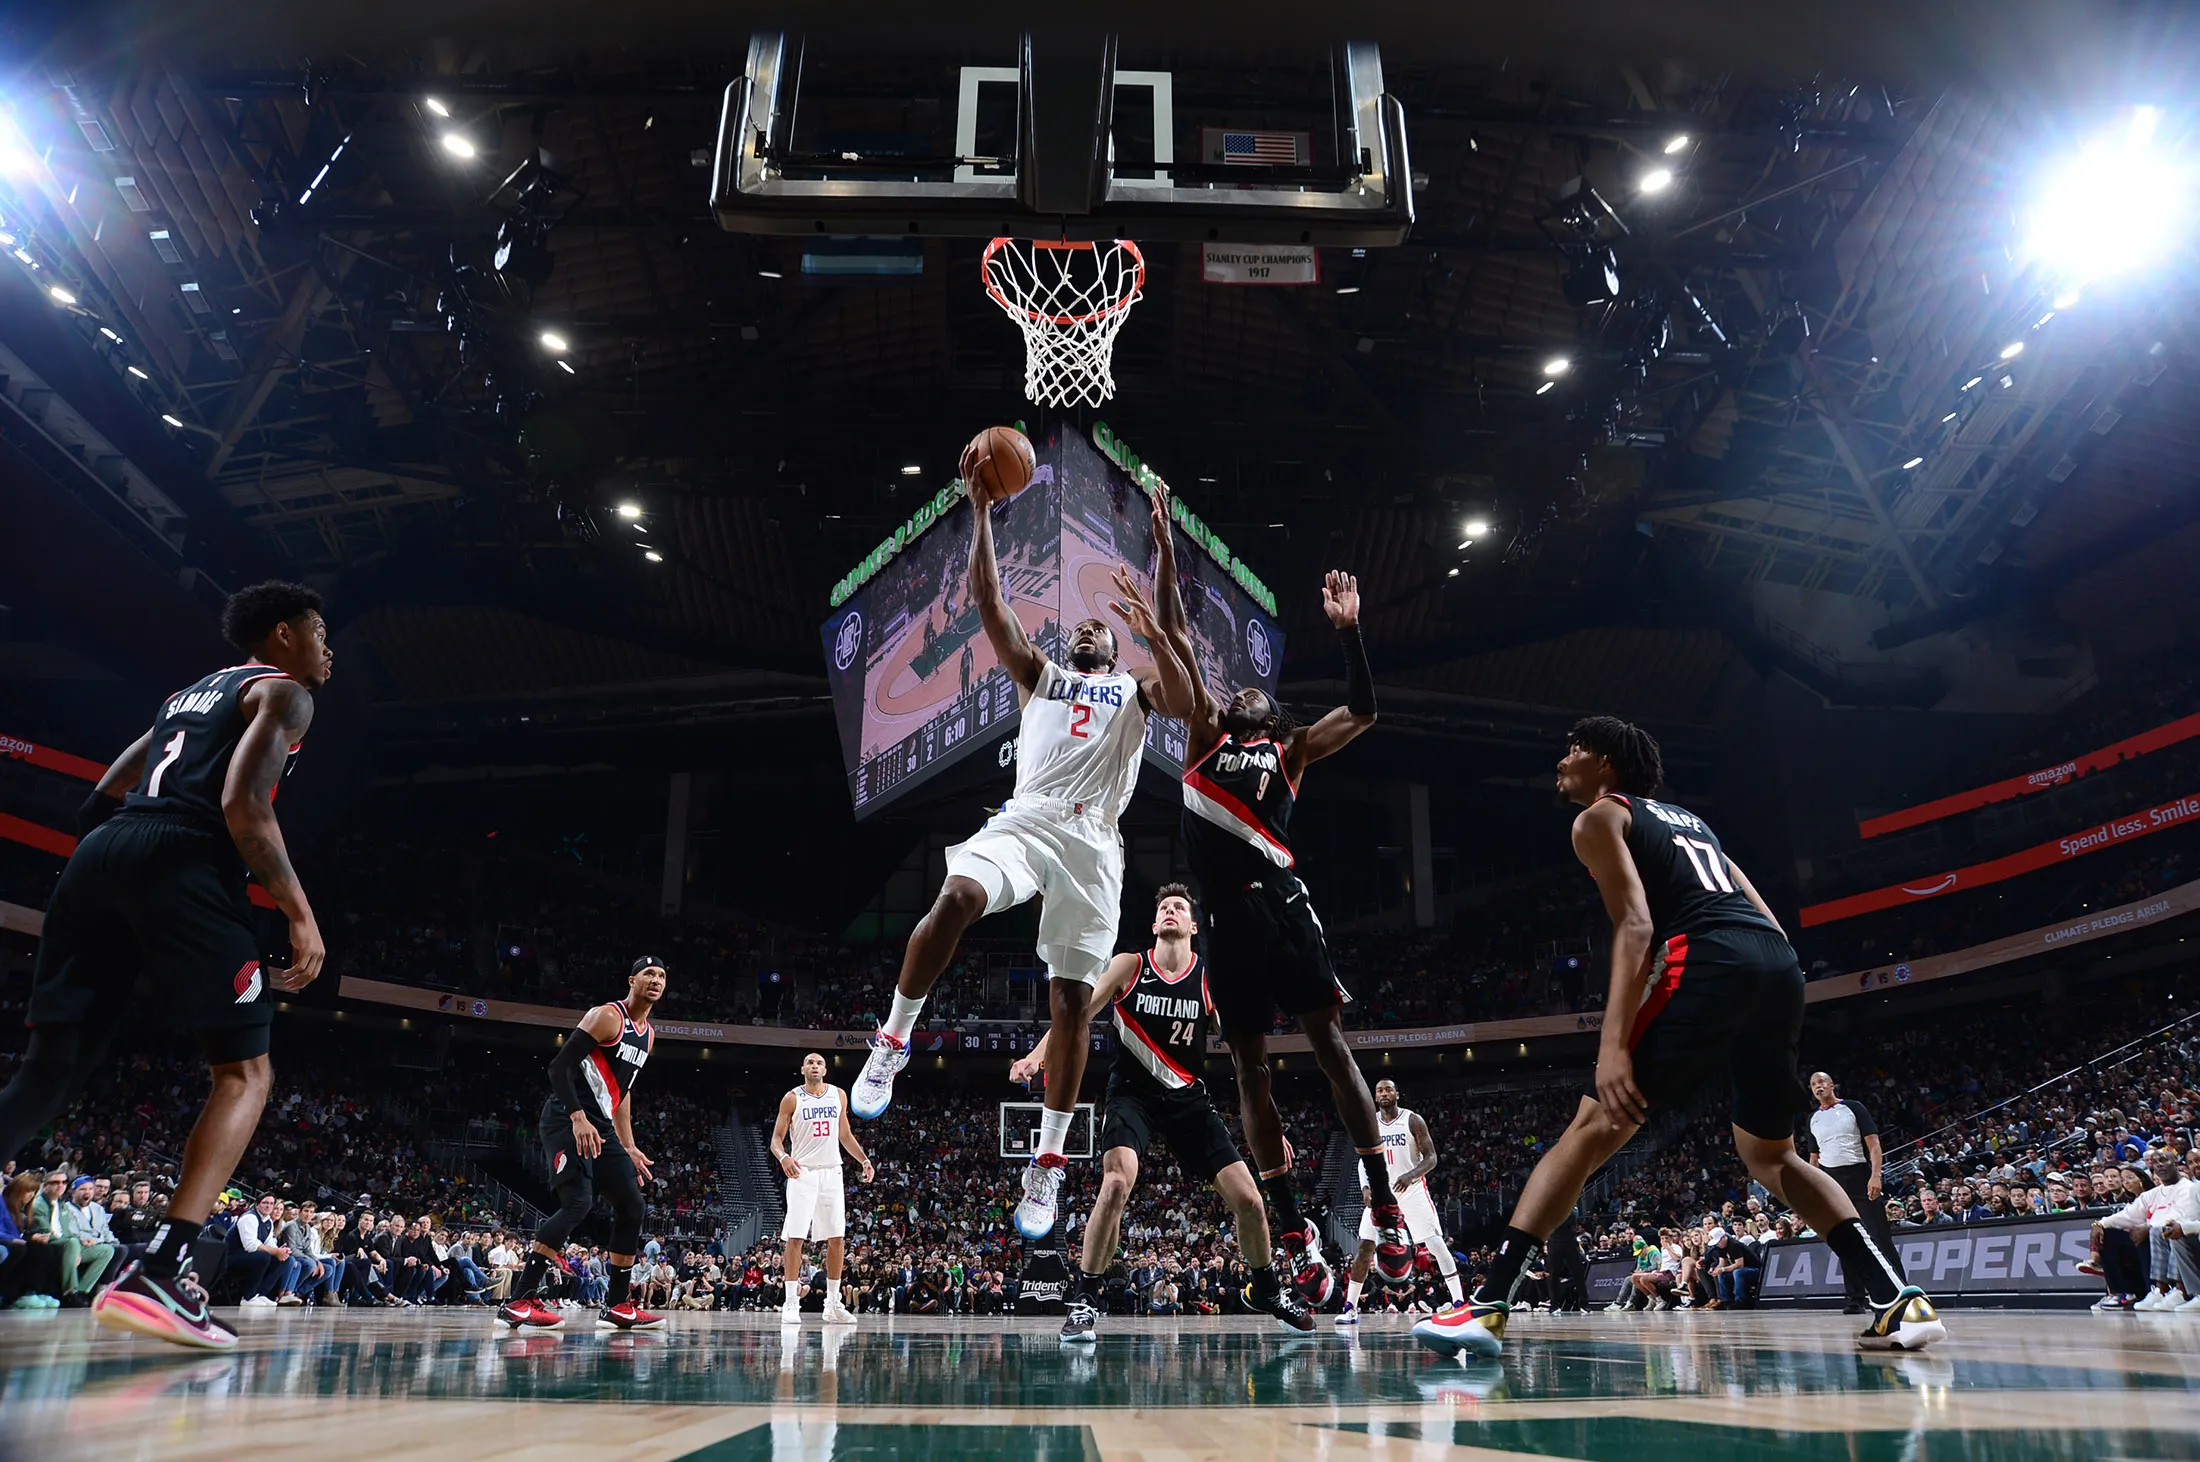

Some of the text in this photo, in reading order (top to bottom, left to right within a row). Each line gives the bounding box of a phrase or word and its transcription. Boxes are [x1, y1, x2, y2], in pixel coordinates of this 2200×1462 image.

[1206, 253, 1312, 264] STANLEY CUP CHAMPIONS
[1248, 267, 1270, 278] 1917
[831, 477, 960, 607] CLIMATE PLEDGE
[1171, 496, 1230, 571] PLEDGE
[1231, 557, 1277, 617] ARENA
[165, 690, 224, 720] SIMONS
[1048, 679, 1122, 708] CLIPPERS
[979, 708, 989, 727] 41
[1071, 704, 1091, 738] 2
[944, 717, 966, 747] 6:10
[0, 736, 33, 755] azon
[926, 743, 933, 762] 2
[1164, 733, 1184, 762] 6:10
[148, 730, 186, 797] 1
[906, 757, 917, 773] 30
[2027, 762, 2077, 786] amazon
[1256, 770, 1270, 801] 9
[2060, 799, 2199, 855] Spend less. Smile
[1672, 834, 1734, 893] 17
[2044, 900, 2170, 943] CLIMATE PLEDGE ARENA
[456, 1000, 466, 1012] VS
[1135, 992, 1200, 1020] PORTLAND
[654, 1024, 724, 1038] PLEDGE ARENA
[965, 1035, 1101, 1051] 30 3 6 2 3
[1169, 1020, 1195, 1046] 24
[1357, 1030, 1466, 1045] CLIMATE PLEDGE ARENA
[616, 1041, 649, 1069] PORTLAN
[802, 1105, 838, 1121] CLIPPERS
[812, 1120, 830, 1138] 33
[1381, 1132, 1407, 1147] PPERS
[1386, 1149, 1394, 1165] 11
[1765, 1229, 2098, 1288] LA PPERS
[1022, 1280, 1060, 1291] Trident
